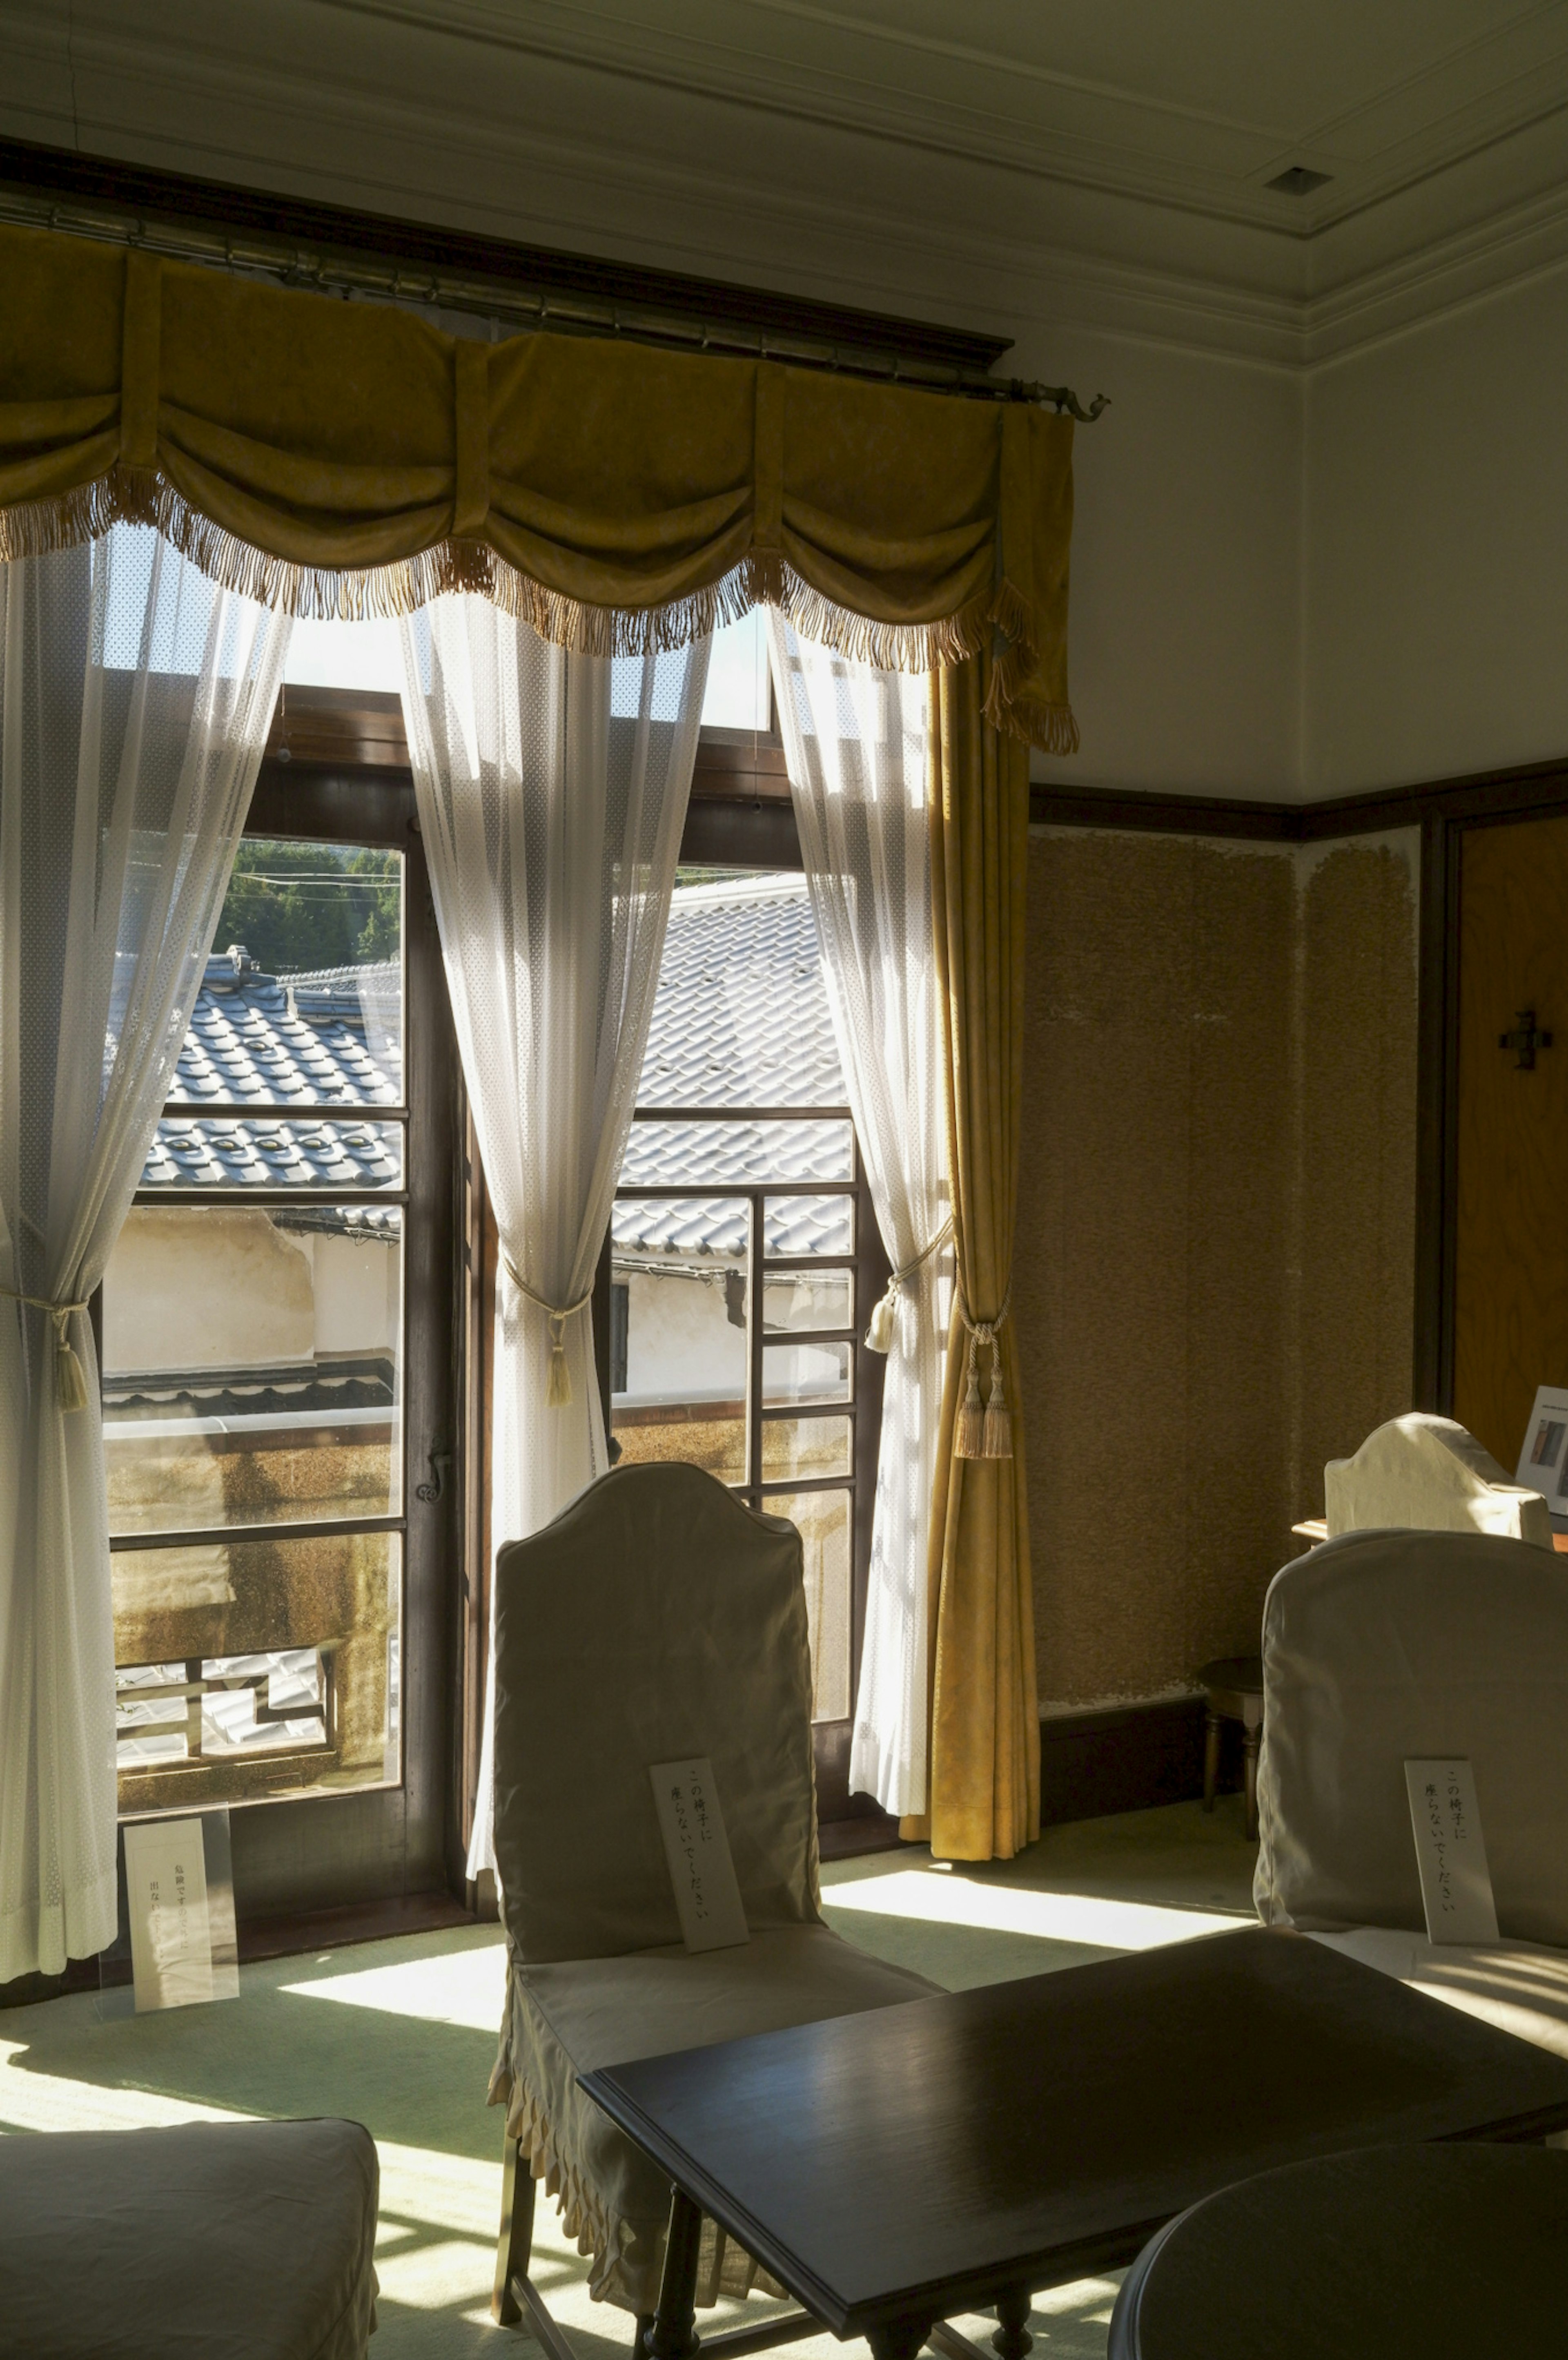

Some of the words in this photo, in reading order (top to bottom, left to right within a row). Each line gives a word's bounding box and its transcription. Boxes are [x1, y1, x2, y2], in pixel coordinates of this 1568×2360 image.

[671, 1787, 708, 1919] 座らないでください
[690, 1771, 712, 1841] この椅子に
[1425, 1783, 1455, 1912] 座らないでください
[1448, 1771, 1466, 1840] この椅子に
